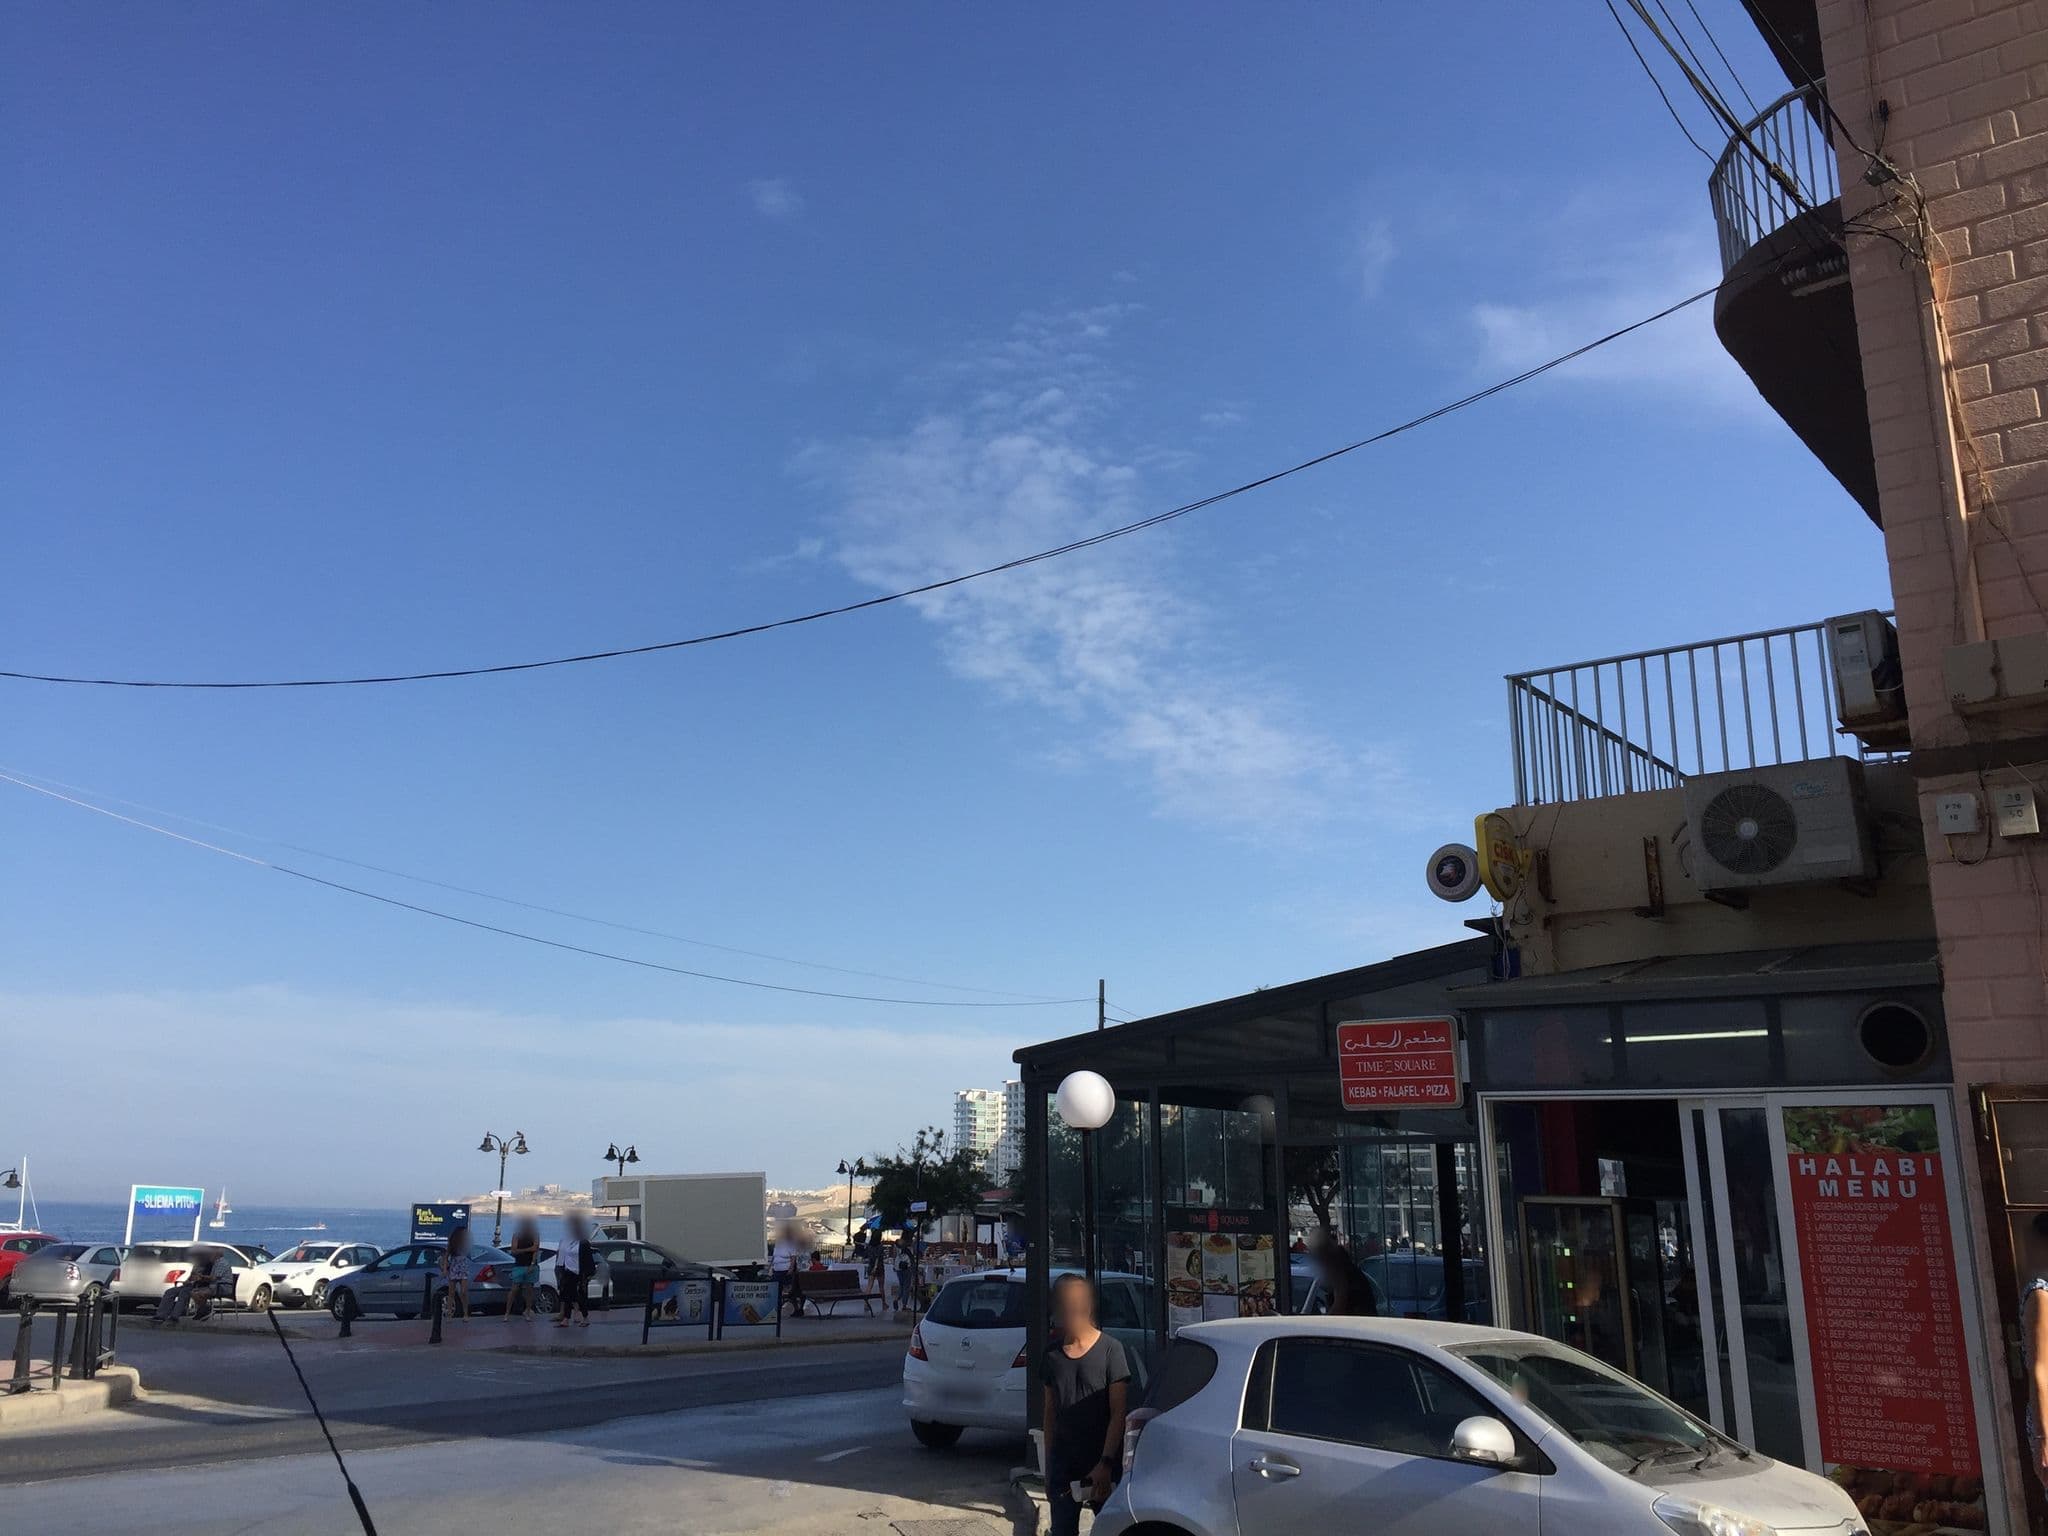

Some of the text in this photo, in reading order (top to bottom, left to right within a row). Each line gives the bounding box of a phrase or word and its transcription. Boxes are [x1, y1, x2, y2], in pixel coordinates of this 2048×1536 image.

[1404, 1031, 1446, 1049] مطعم
[1356, 1059, 1436, 1072] TIME SQUARE
[1348, 1084, 1450, 1098] KEBAB FALAFEL PIZZA
[1798, 1158, 1933, 1176] HALABI
[1818, 1180, 1916, 1198] MENU
[144, 1194, 174, 1208] SLIEMA
[1878, 1202, 1899, 1211] WRAP
[1867, 1213, 1889, 1222] WRAP
[1857, 1224, 1879, 1232] WRAP
[1851, 1276, 1875, 1286] DONER
[1876, 1277, 1894, 1286] WITH
[1895, 1278, 1918, 1287] SALAD
[1867, 1287, 1886, 1297] WITH
[1886, 1288, 1910, 1298] SALAD
[1863, 1298, 1880, 1308] WITH
[1880, 1298, 1904, 1309] SALAD
[1884, 1310, 1902, 1320] WITH
[1903, 1311, 1927, 1321] SALAD
[1828, 1318, 1857, 1329] CHICKEN
[1879, 1320, 1898, 1331] WITH
[1898, 1321, 1922, 1332] SALAD
[1869, 1331, 1886, 1341] WITH
[1887, 1332, 1910, 1342] SALAD
[1865, 1342, 1882, 1352] WITH
[1883, 1343, 1906, 1353] SALAD
[1873, 1353, 1892, 1363] WITH
[1893, 1354, 1916, 1364] SALAD
[1916, 1366, 1939, 1377] SALAD
[1908, 1377, 1931, 1388] SALAD
[1860, 1396, 1883, 1406] SALAD
[1838, 1406, 1857, 1416] SMALL
[1860, 1407, 1883, 1418] SALAD
[1838, 1416, 1865, 1428] VEGGIE
[1866, 1418, 1894, 1430] BURGER
[1894, 1420, 1914, 1432] WITH
[1914, 1421, 1937, 1433] CHIPS
[1856, 1429, 1886, 1440] BURGER
[1886, 1431, 1904, 1442] WITH
[1905, 1432, 1928, 1443] CHIPS
[1872, 1441, 1902, 1453] BURGER
[1902, 1443, 1920, 1454] WITH
[1921, 1445, 1944, 1456] CHIPS
[1861, 1451, 1890, 1463] BURGER
[1891, 1453, 1910, 1465] WITH
[1910, 1455, 1932, 1467] CHIPS
